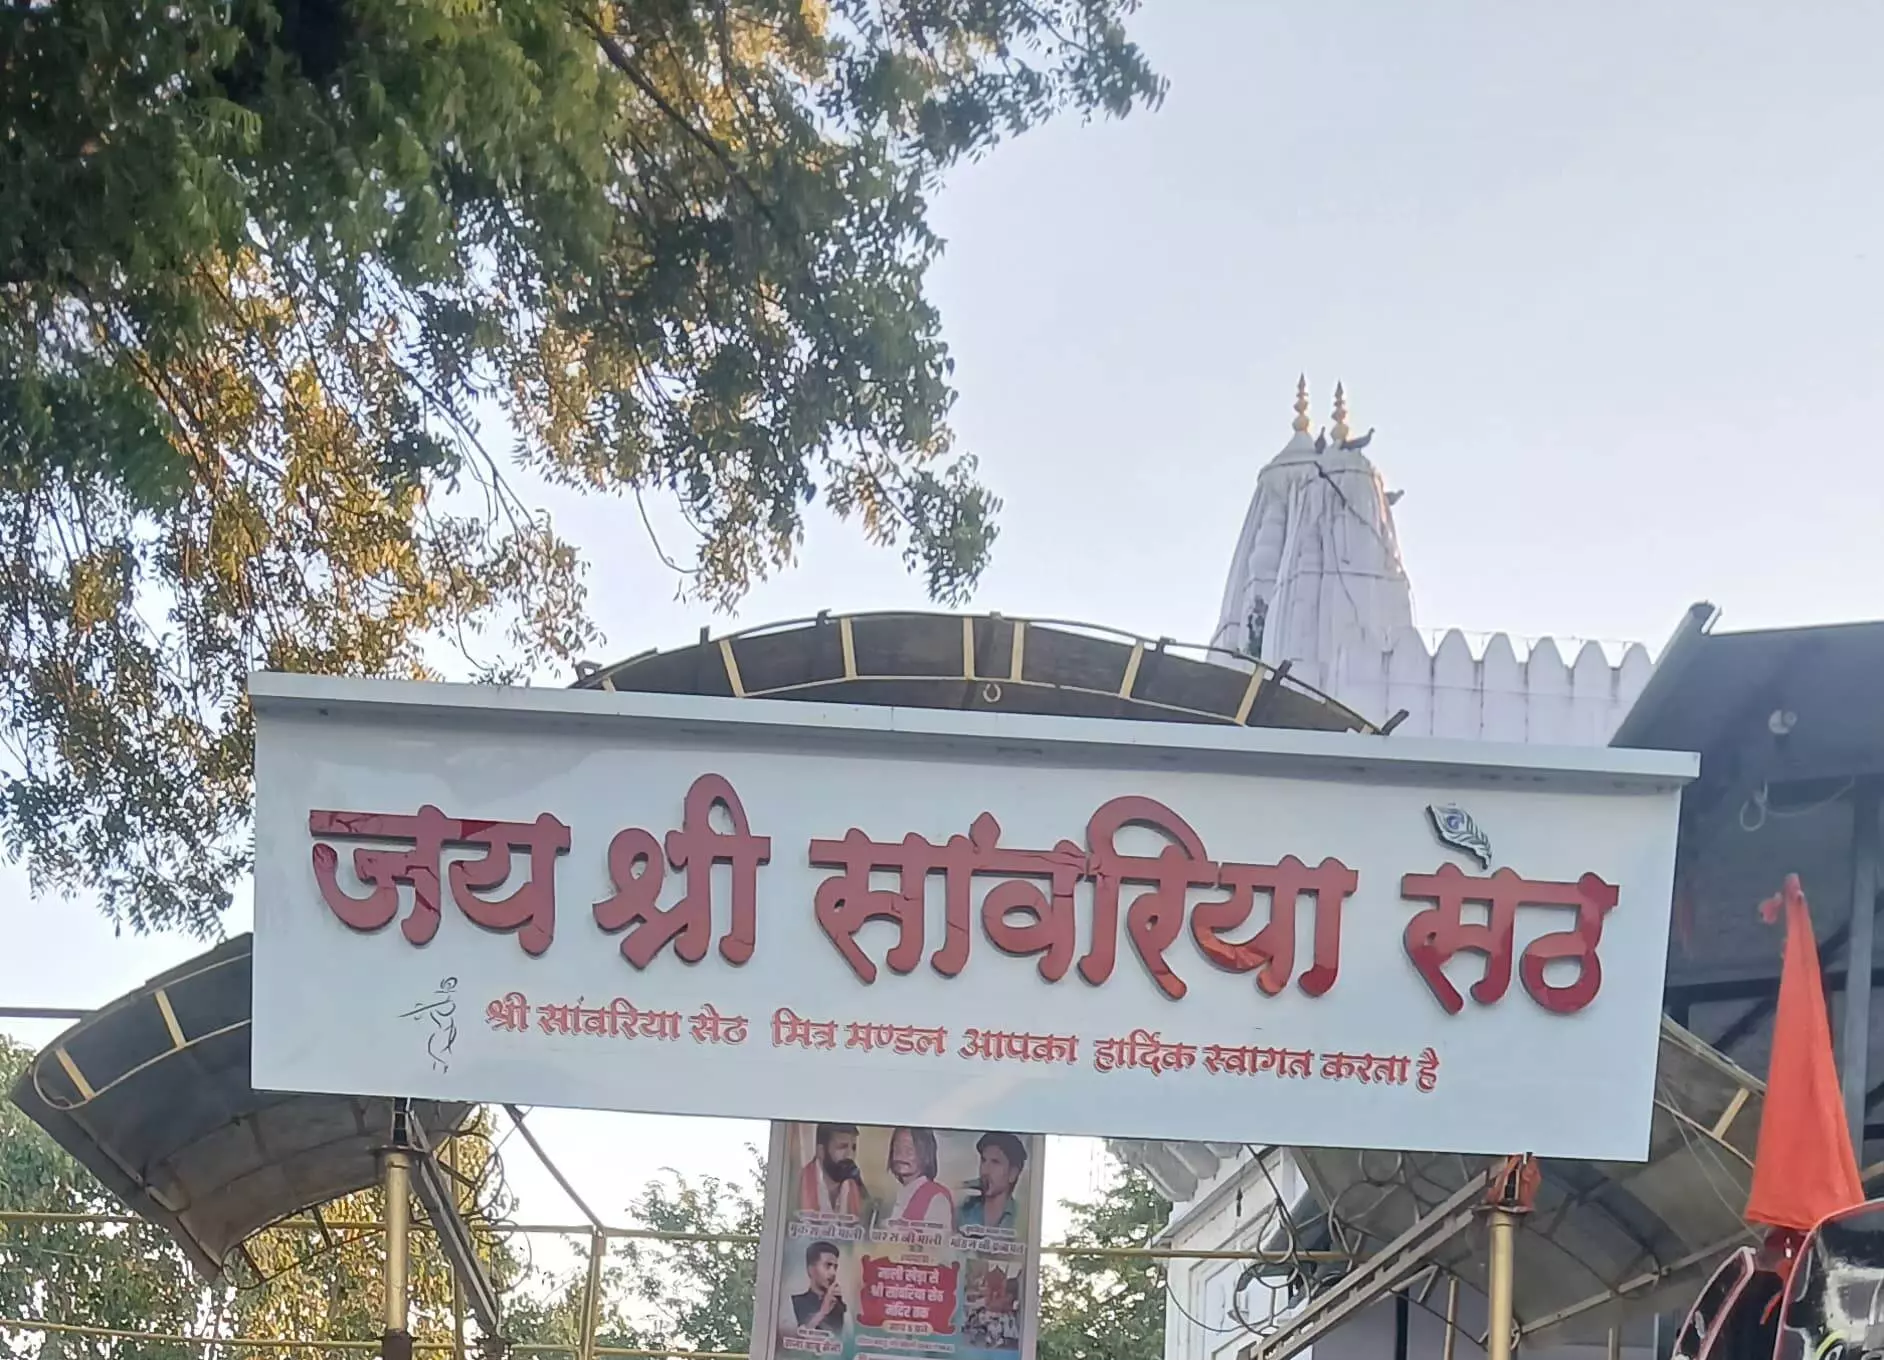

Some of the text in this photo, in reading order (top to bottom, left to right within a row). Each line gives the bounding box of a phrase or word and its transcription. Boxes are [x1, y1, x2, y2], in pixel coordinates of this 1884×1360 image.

[309, 805, 572, 956] जय
[592, 772, 771, 969] श्री
[808, 795, 1358, 1000] सांवरिया
[485, 992, 1439, 1093] श्री सांवरिया सेठ मित्र मण्डल आपका हार्दिक स्वागत करता है
